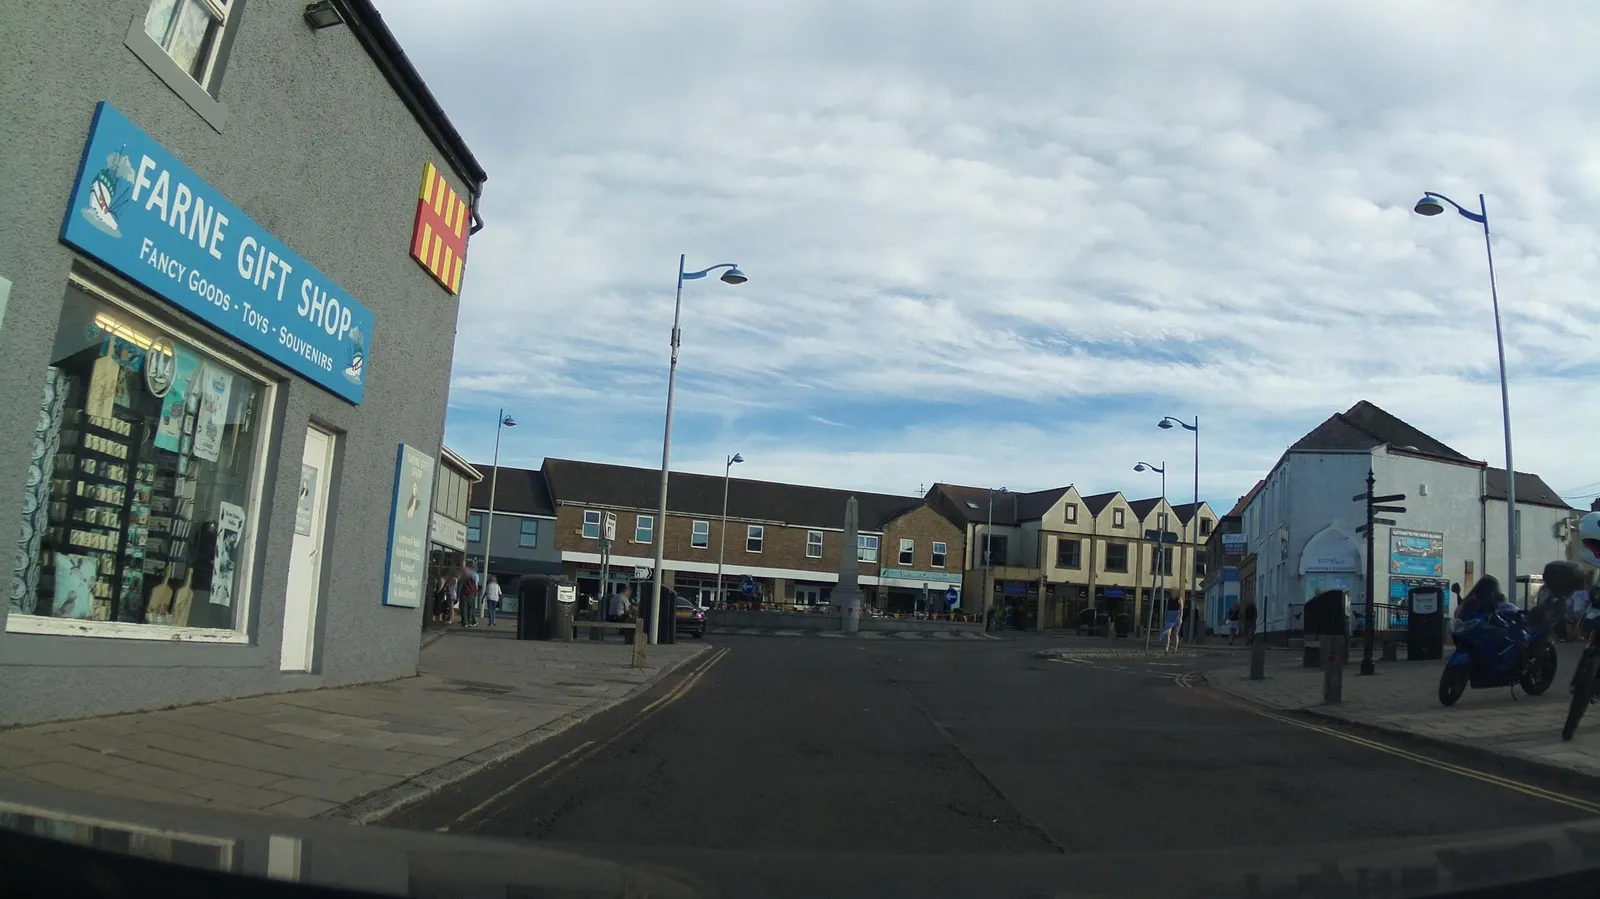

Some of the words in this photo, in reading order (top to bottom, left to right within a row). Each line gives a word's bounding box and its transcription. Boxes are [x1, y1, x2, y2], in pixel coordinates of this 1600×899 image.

[131, 154, 229, 260] FARNE
[237, 236, 293, 301] GIFT
[297, 278, 352, 341] SHOP
[139, 237, 187, 283] FANCY
[188, 269, 231, 312] GOODS
[243, 301, 269, 334] TOYS
[278, 325, 333, 372] SOUVENIRS
